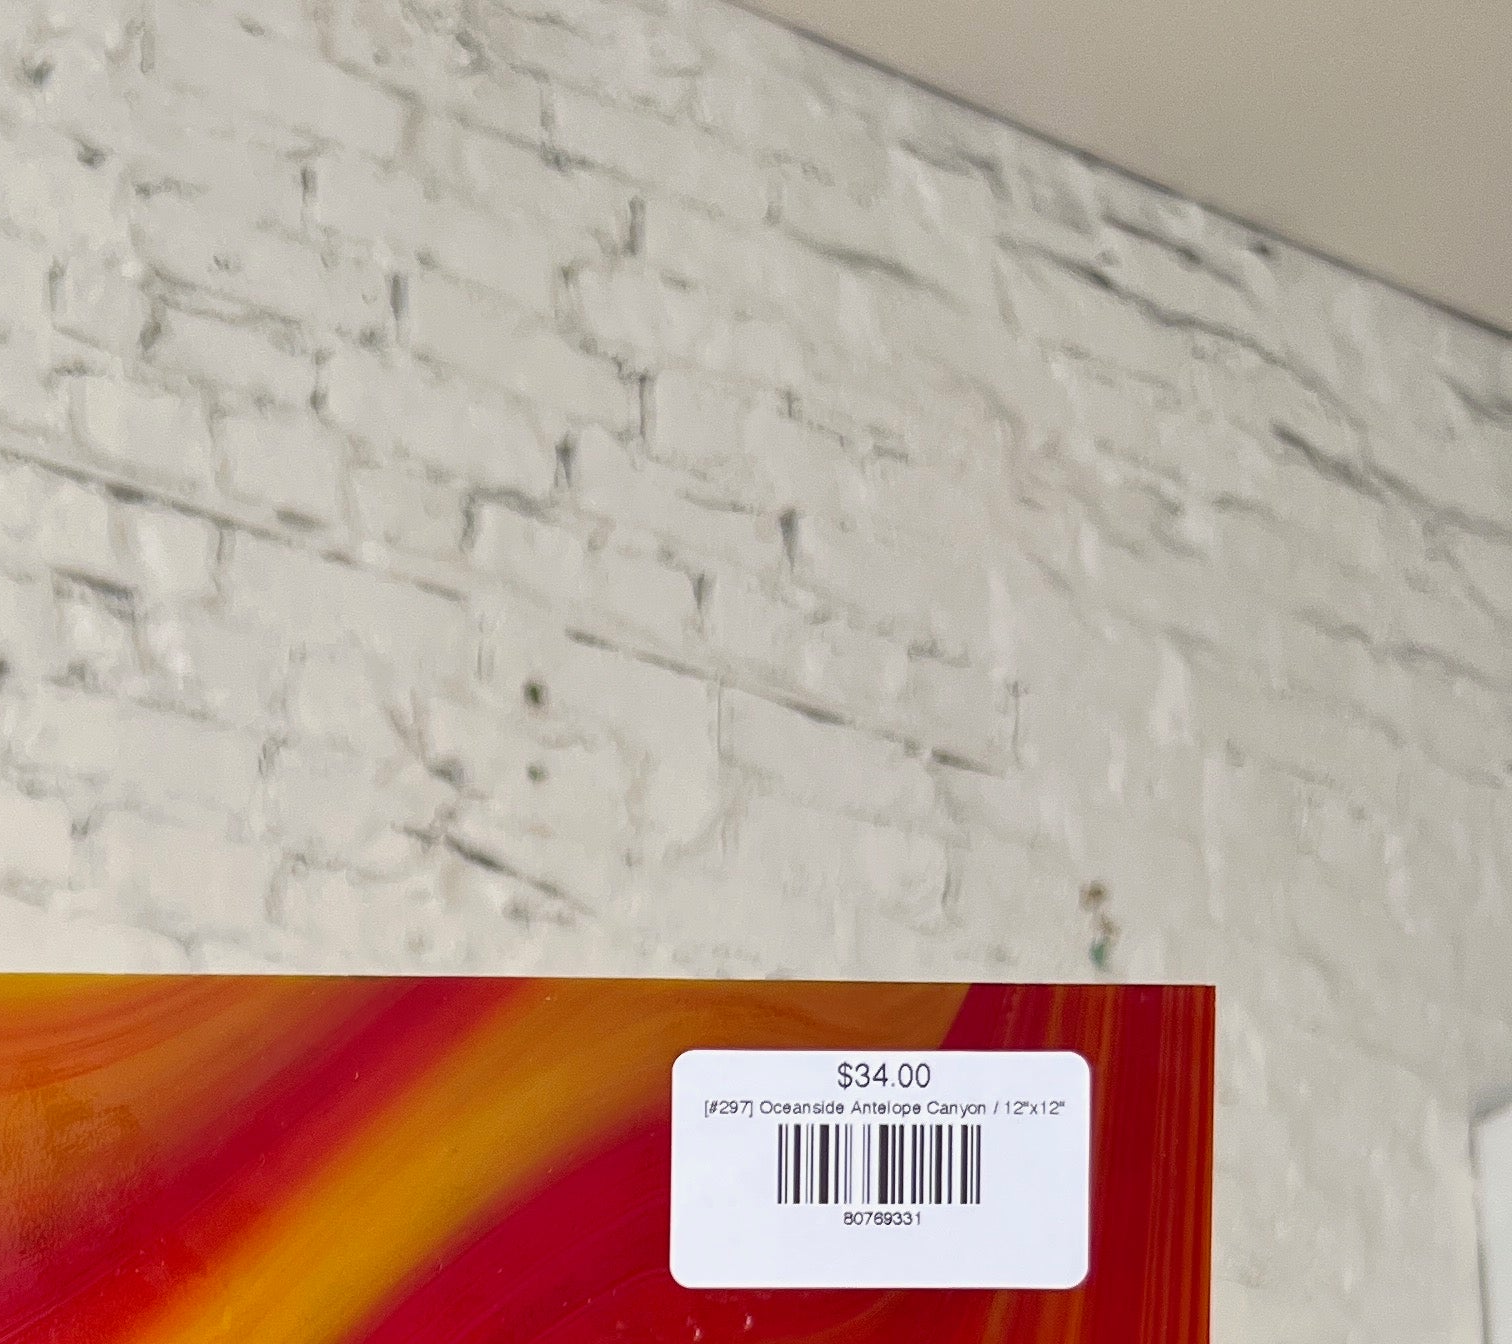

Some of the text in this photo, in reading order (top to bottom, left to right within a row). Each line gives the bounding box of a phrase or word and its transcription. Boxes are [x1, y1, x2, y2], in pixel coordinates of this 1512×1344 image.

[837, 1061, 931, 1090] $34.00
[704, 1099, 754, 1119] [#297]
[759, 1099, 845, 1116] Oceanside
[850, 1100, 922, 1118] Antelope
[926, 1100, 987, 1119] Canyon
[1004, 1100, 1066, 1116] 12"x12"
[843, 1210, 922, 1226] 80769331
